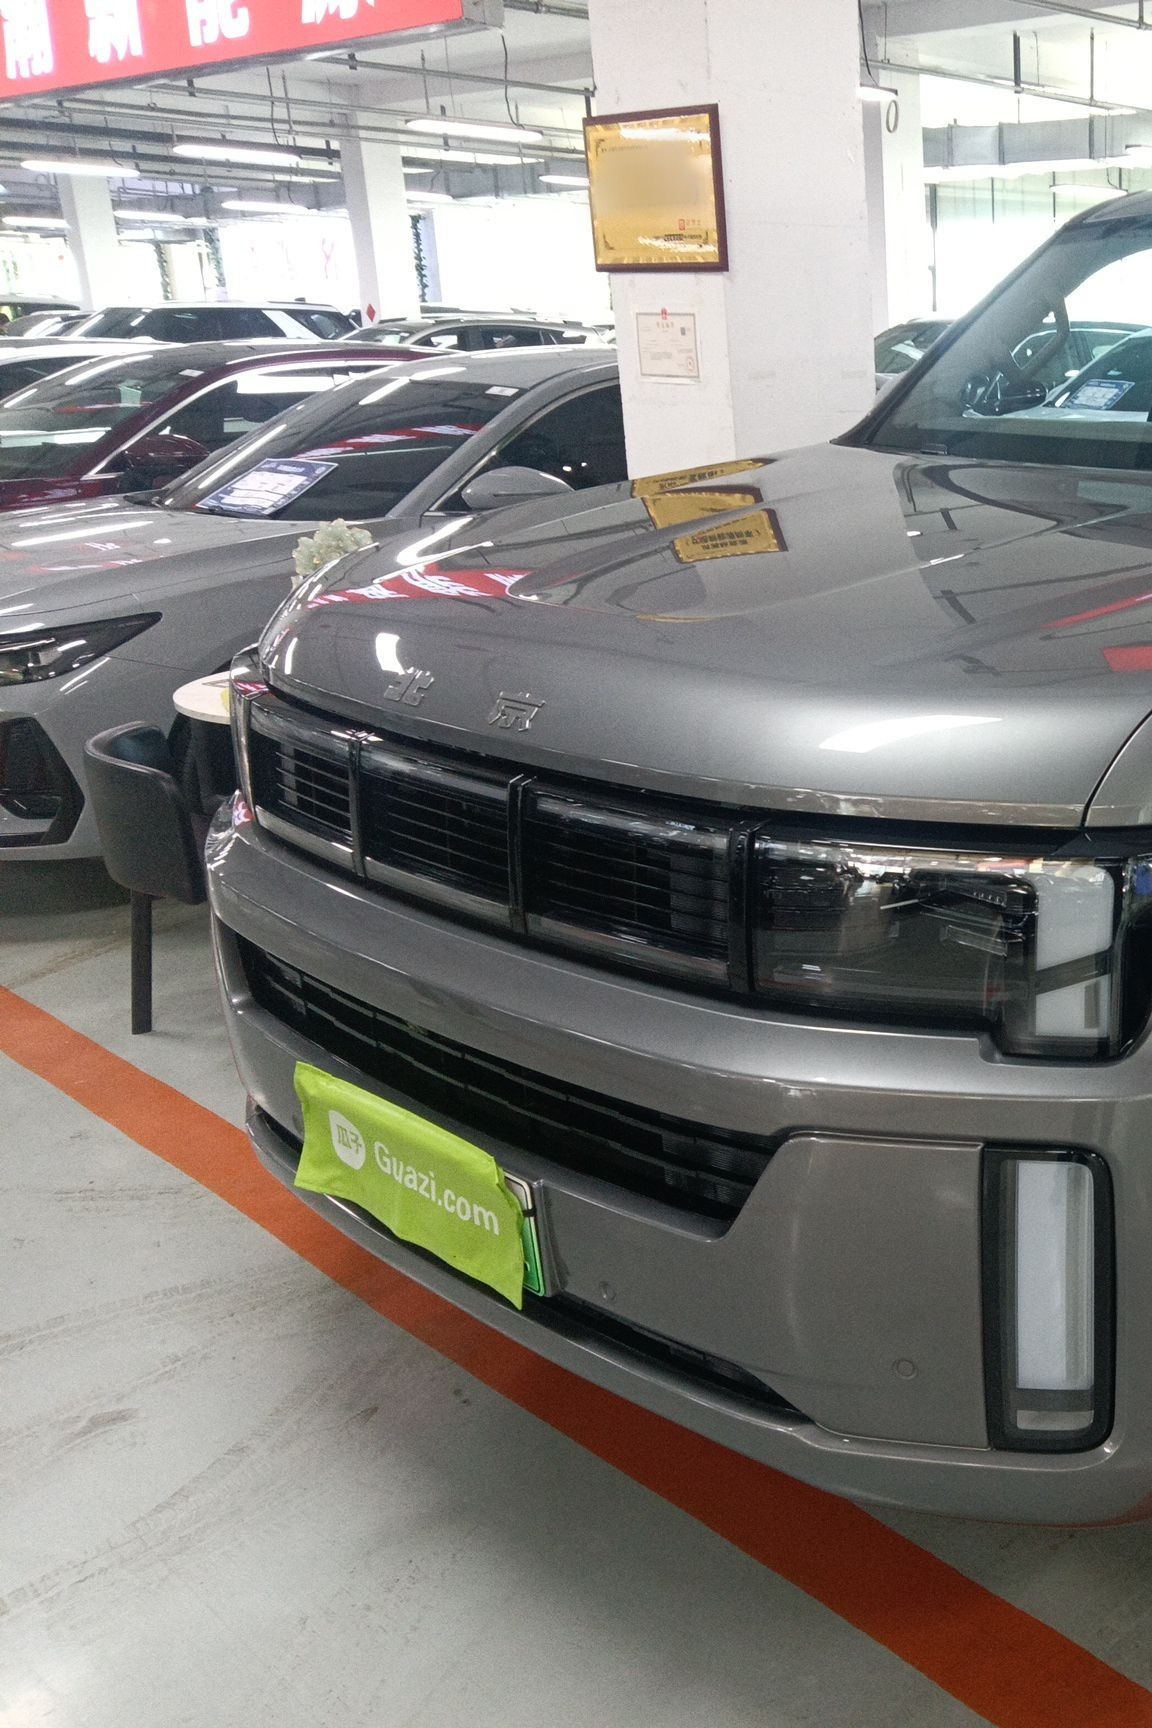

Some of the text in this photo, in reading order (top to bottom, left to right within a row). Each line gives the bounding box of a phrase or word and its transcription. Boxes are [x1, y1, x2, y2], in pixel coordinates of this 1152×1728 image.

[384, 666, 546, 732] 北京
[337, 1124, 363, 1154] 瓜子
[374, 1141, 499, 1235] Guazi.com
